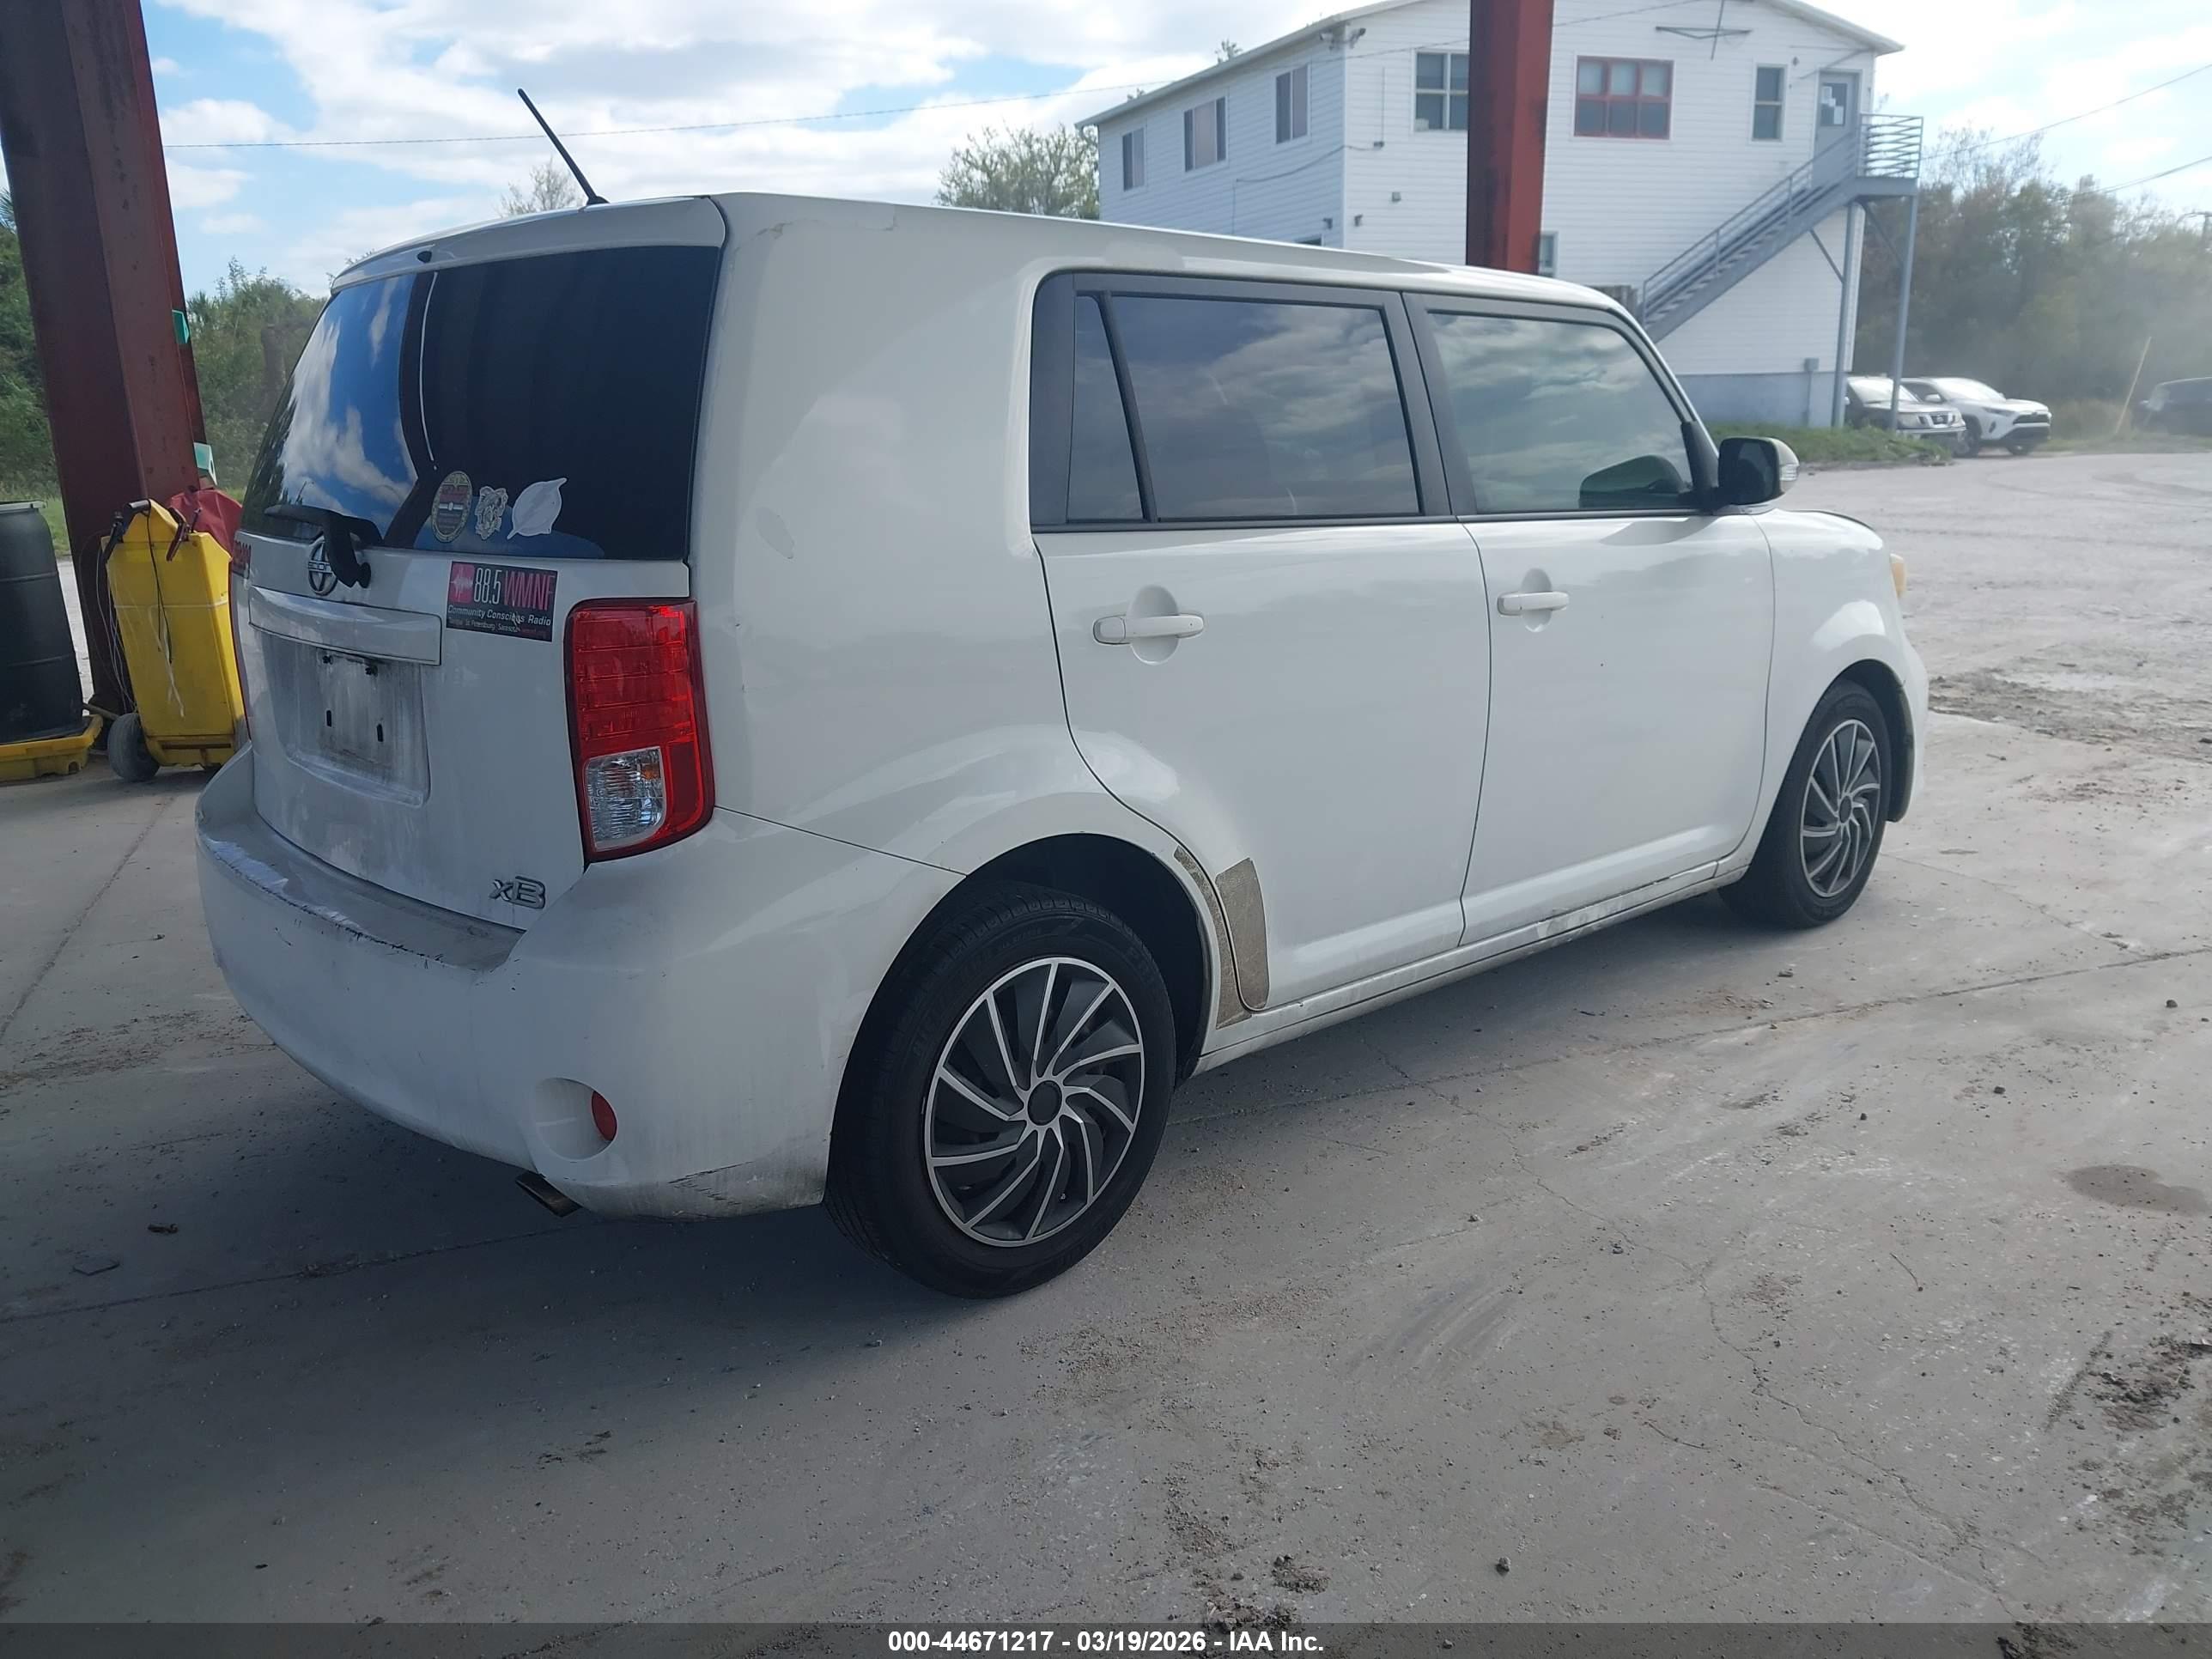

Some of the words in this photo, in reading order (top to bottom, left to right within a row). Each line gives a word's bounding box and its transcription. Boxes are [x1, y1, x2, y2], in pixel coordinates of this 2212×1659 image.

[473, 567, 503, 605] 88.5
[503, 570, 556, 611] WMNF
[447, 605, 486, 619] Community
[527, 614, 551, 626] Radio
